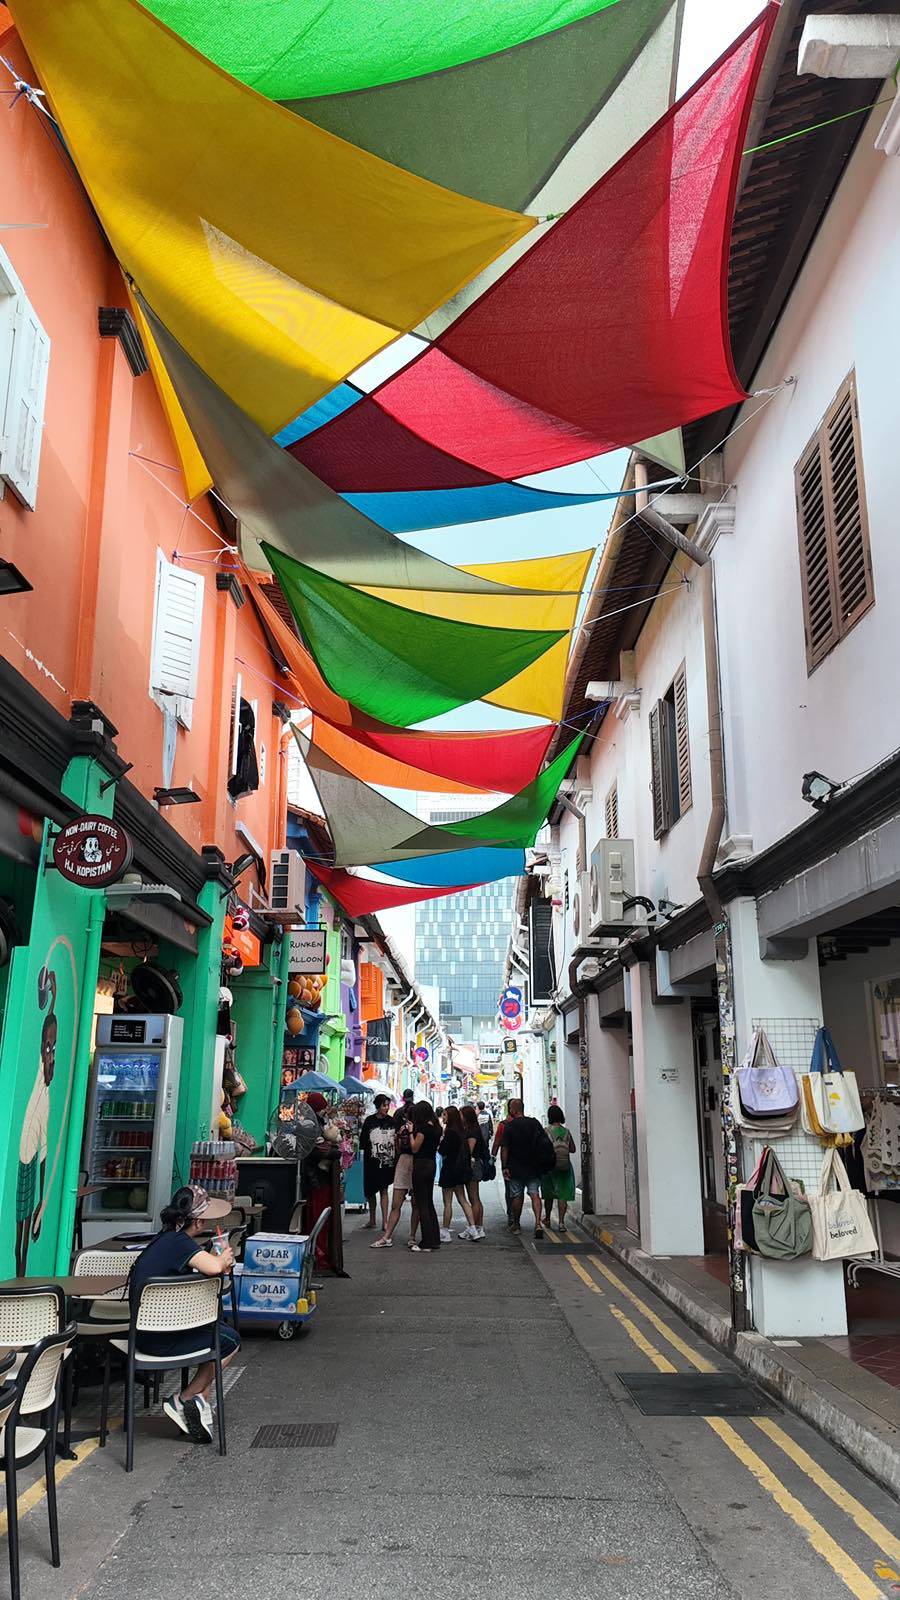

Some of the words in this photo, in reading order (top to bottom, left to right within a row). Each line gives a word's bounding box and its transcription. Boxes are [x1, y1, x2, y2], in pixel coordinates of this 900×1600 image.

[65, 822, 97, 837] NON-DAIRY
[98, 823, 118, 839] COFFEE
[64, 858, 75, 874] HJ.
[76, 860, 112, 877] KOPISTAN
[830, 1225, 858, 1239] beloved
[255, 1248, 289, 1259] POLAR
[252, 1284, 286, 1294] POLAR
